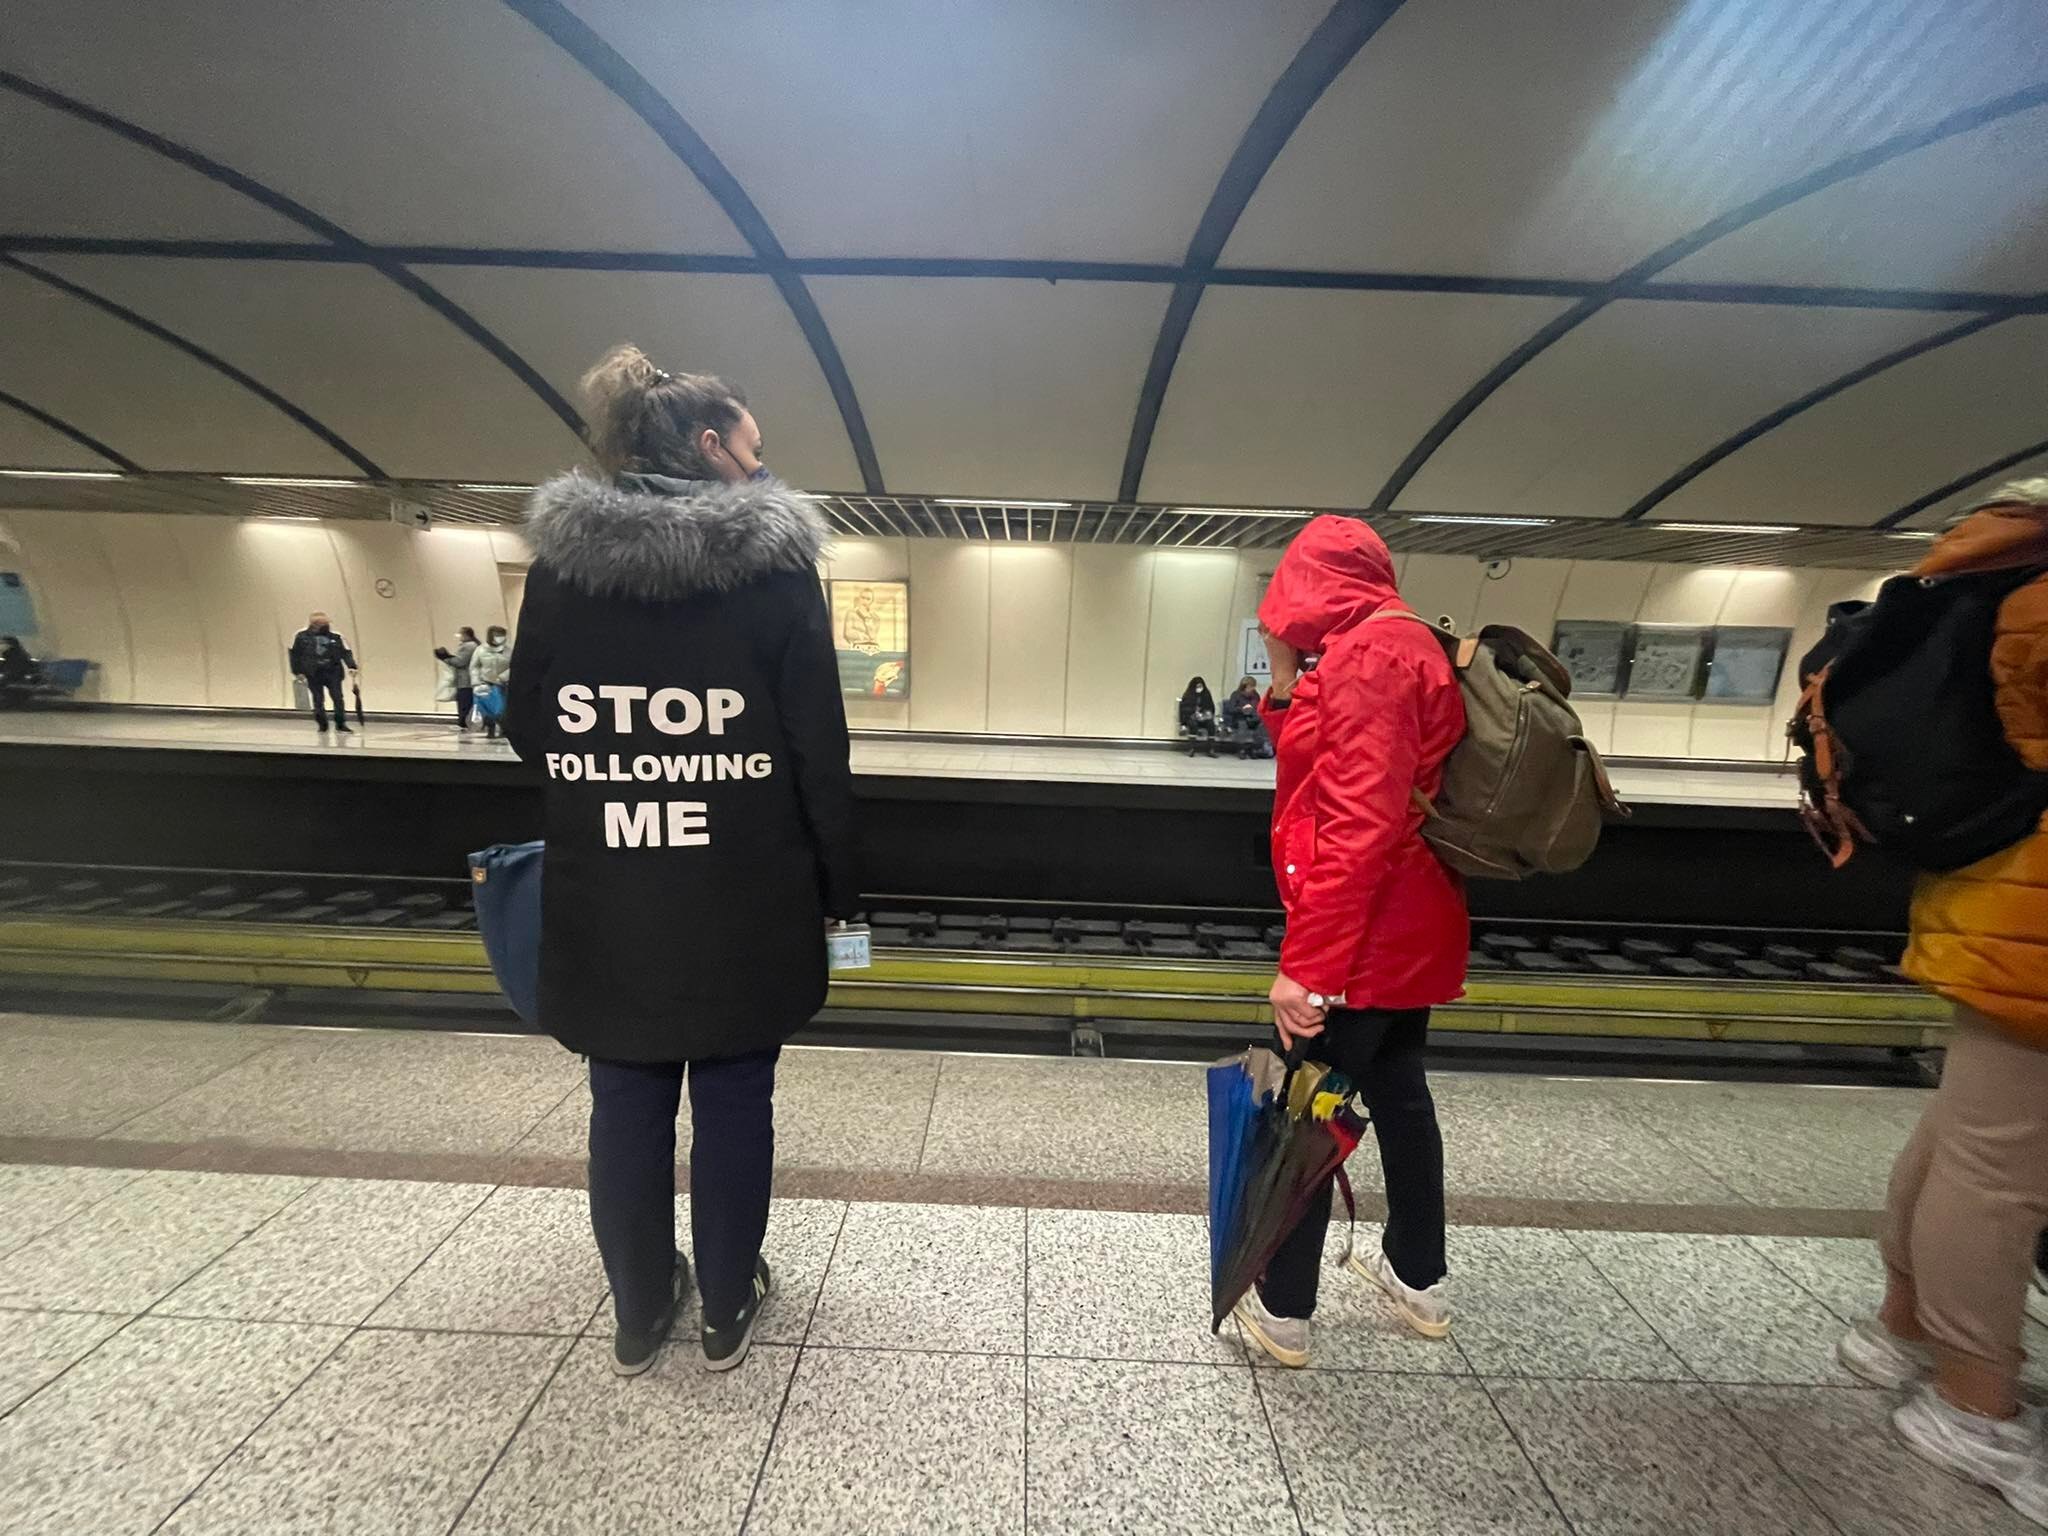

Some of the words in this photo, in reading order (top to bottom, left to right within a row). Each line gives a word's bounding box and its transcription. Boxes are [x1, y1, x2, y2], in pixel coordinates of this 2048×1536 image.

[557, 684, 746, 735] STOP
[545, 752, 773, 782] FOLLOWING
[604, 801, 710, 848] ME
